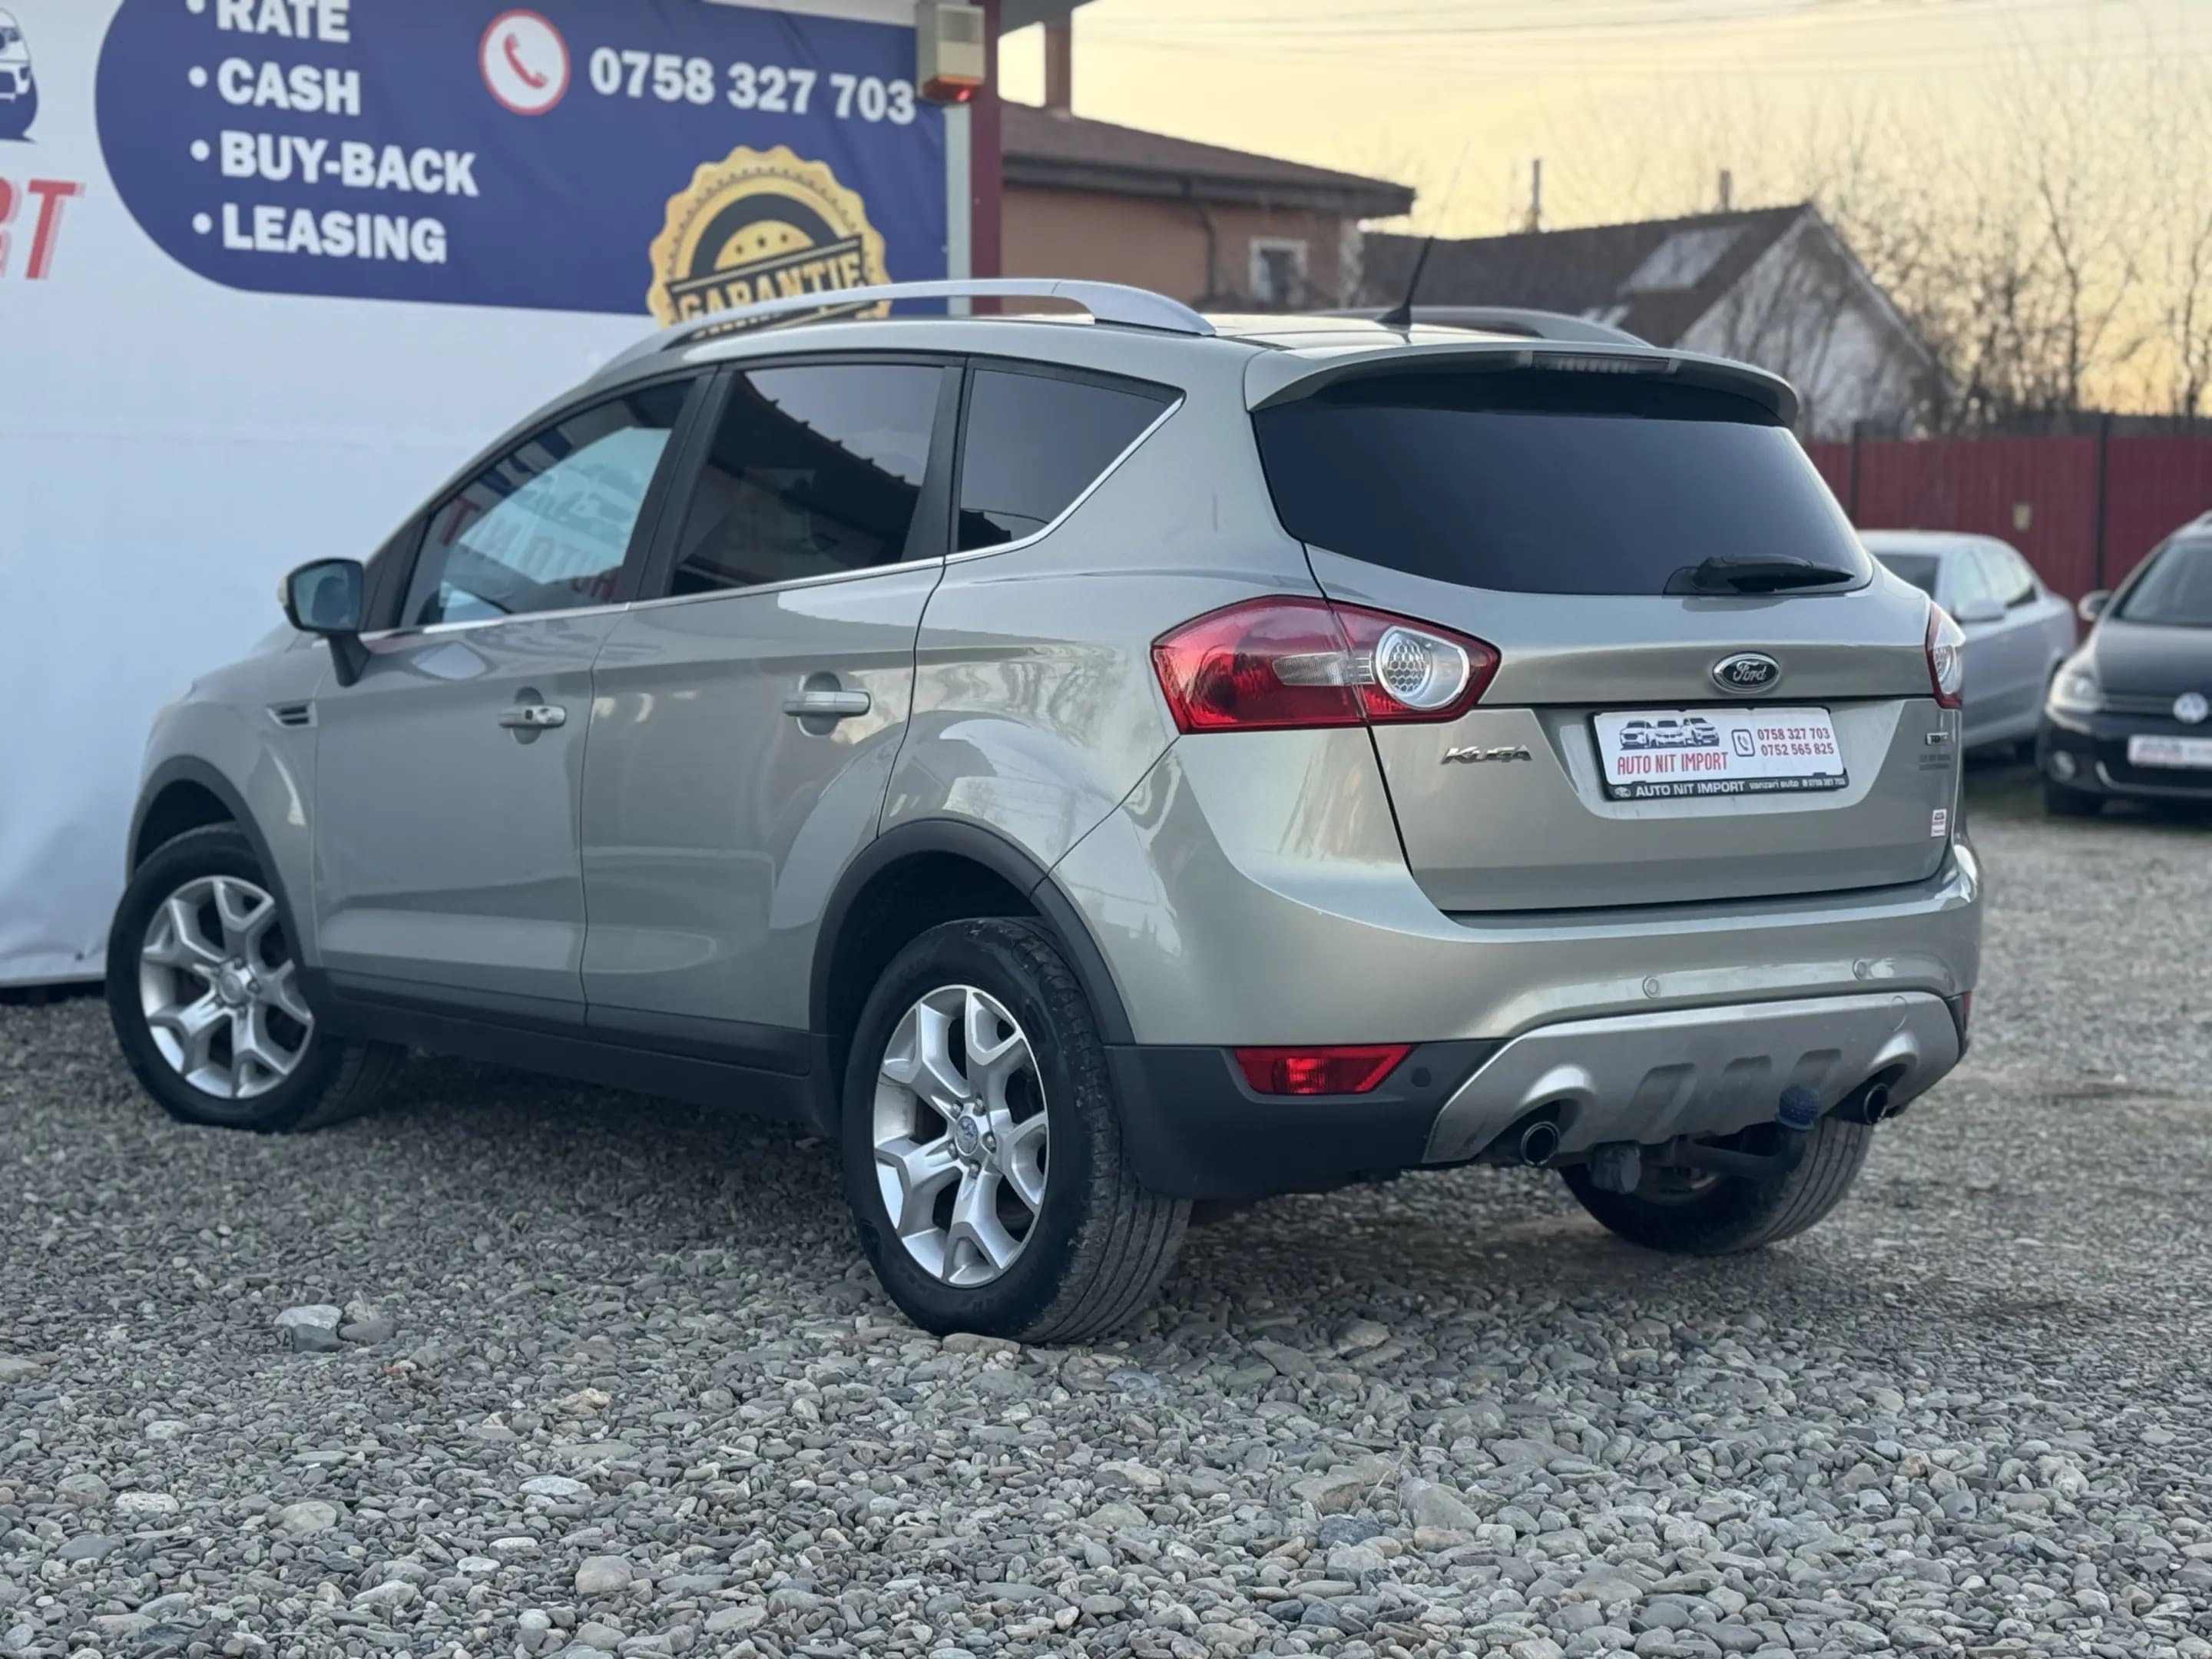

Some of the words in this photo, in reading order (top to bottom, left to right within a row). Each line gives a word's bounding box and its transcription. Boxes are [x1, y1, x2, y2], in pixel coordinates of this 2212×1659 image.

[217, 0, 350, 43] RATE
[217, 58, 361, 116] CASH
[590, 47, 715, 105] 0758
[727, 63, 816, 114] 327
[830, 74, 916, 125] 703
[220, 130, 480, 197] BUY-BACK
[222, 203, 447, 264] LEASING
[1732, 661, 1767, 681] Ford
[1757, 727, 1785, 740] 0758
[1786, 727, 1806, 740] 327
[1809, 727, 1830, 740] 703
[1760, 743, 1790, 756] 0752
[1791, 743, 1812, 755] 565
[1813, 743, 1835, 755] 825
[1617, 756, 1651, 776] AUTO
[1655, 753, 1677, 773] NIT
[1681, 751, 1729, 772] IMPORT
[1635, 784, 1671, 798] AUTO
[1674, 783, 1695, 796] NIT
[1697, 780, 1746, 794] IMPORT
